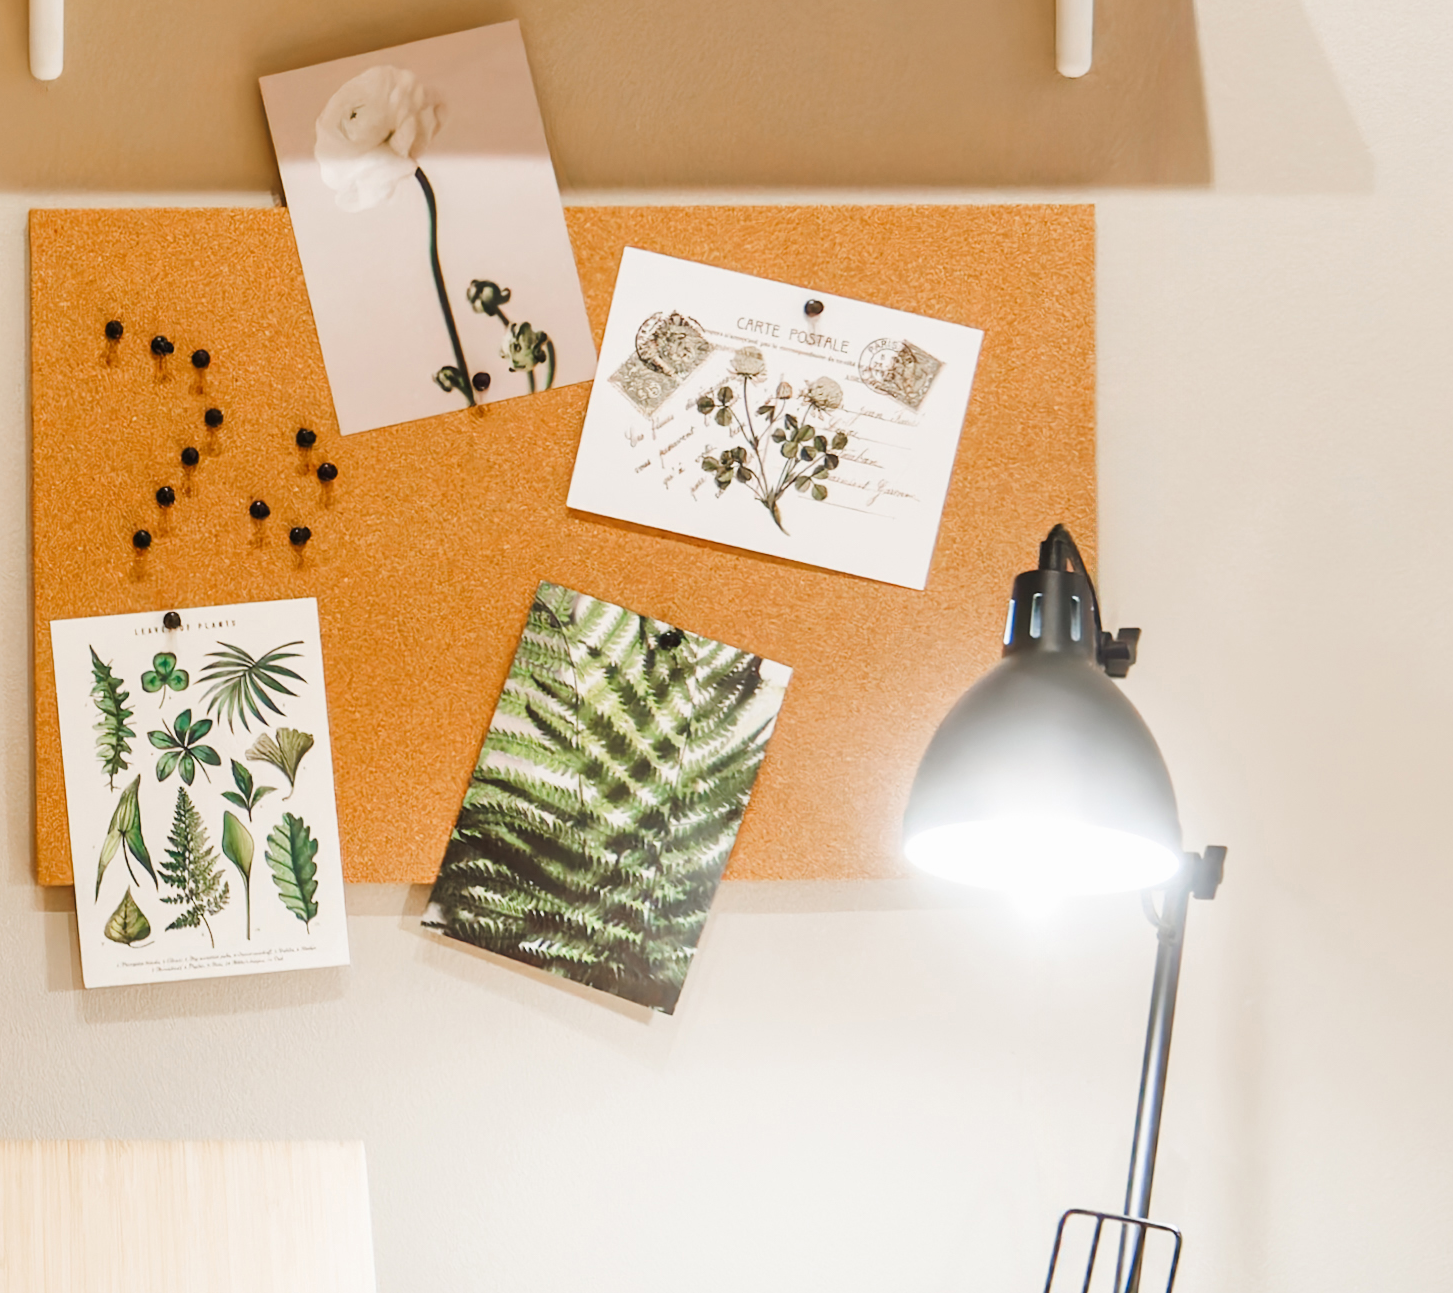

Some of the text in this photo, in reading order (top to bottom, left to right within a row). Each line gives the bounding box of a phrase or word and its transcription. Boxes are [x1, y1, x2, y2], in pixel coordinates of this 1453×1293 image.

[736, 316, 781, 339] CARTE
[788, 327, 850, 355] POSTALE
[868, 339, 899, 353] PARIS
[197, 619, 236, 630] PLANTS
